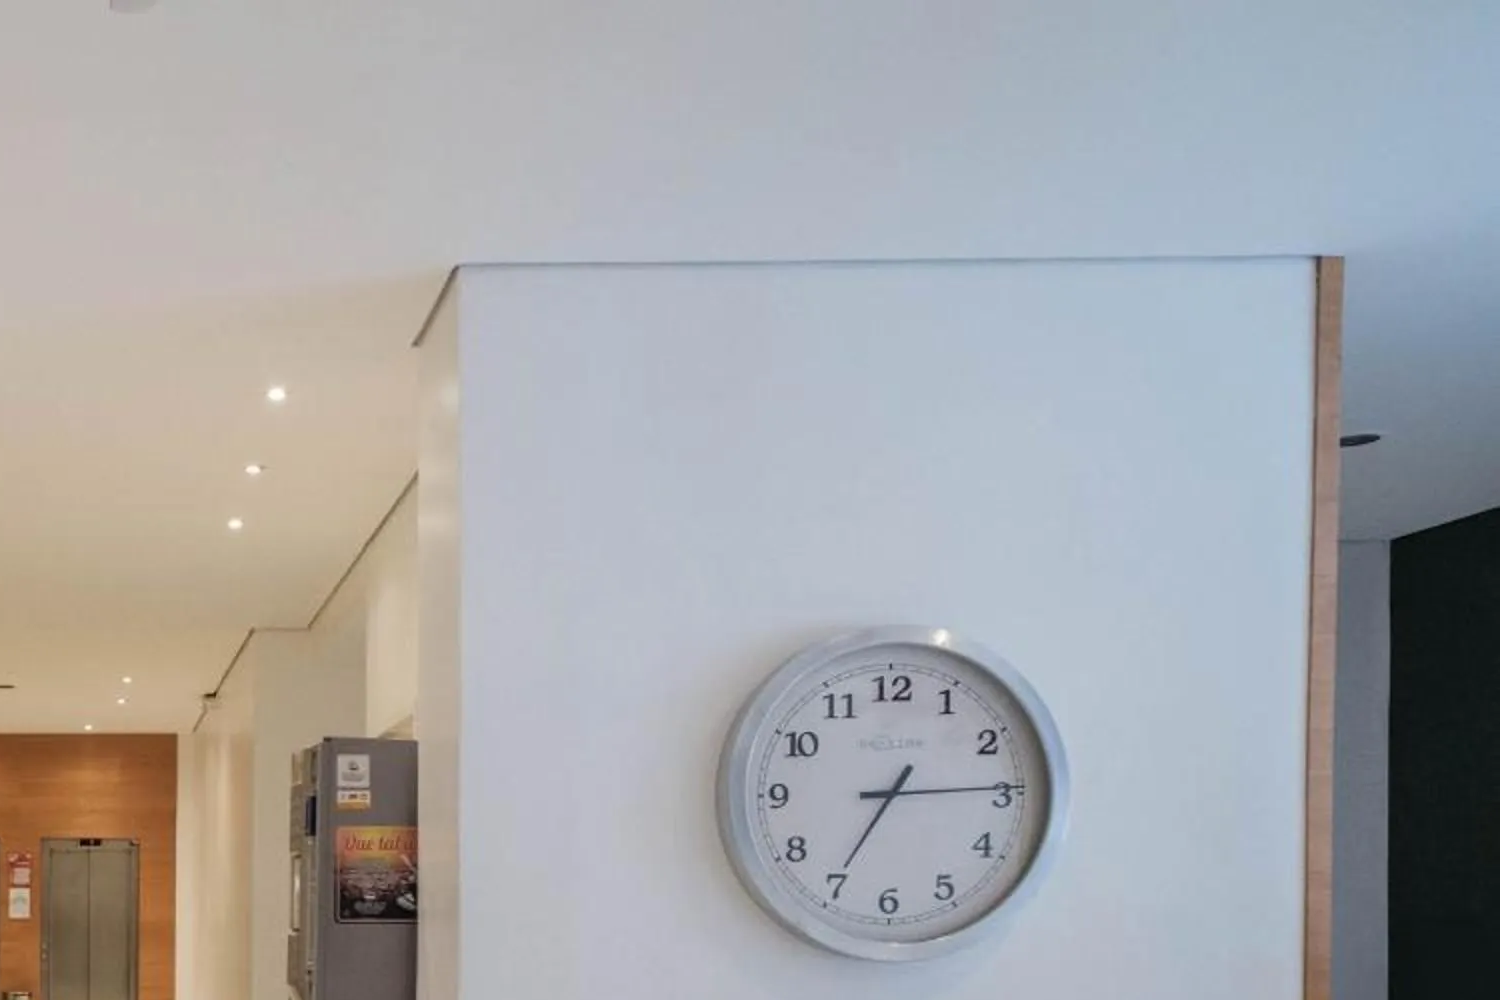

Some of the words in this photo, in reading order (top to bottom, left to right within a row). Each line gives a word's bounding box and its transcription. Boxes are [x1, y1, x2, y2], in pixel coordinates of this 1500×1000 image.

[871, 675, 913, 703] 12
[938, 688, 956, 716] 1
[822, 692, 857, 720] 11
[784, 731, 819, 758] 10
[976, 728, 999, 756] 2
[768, 783, 789, 809] 9
[991, 782, 1013, 809] 3
[785, 835, 807, 863] 8
[971, 831, 994, 859] 4
[826, 873, 848, 900] 7
[934, 875, 955, 900] 5
[878, 888, 900, 915] 6
